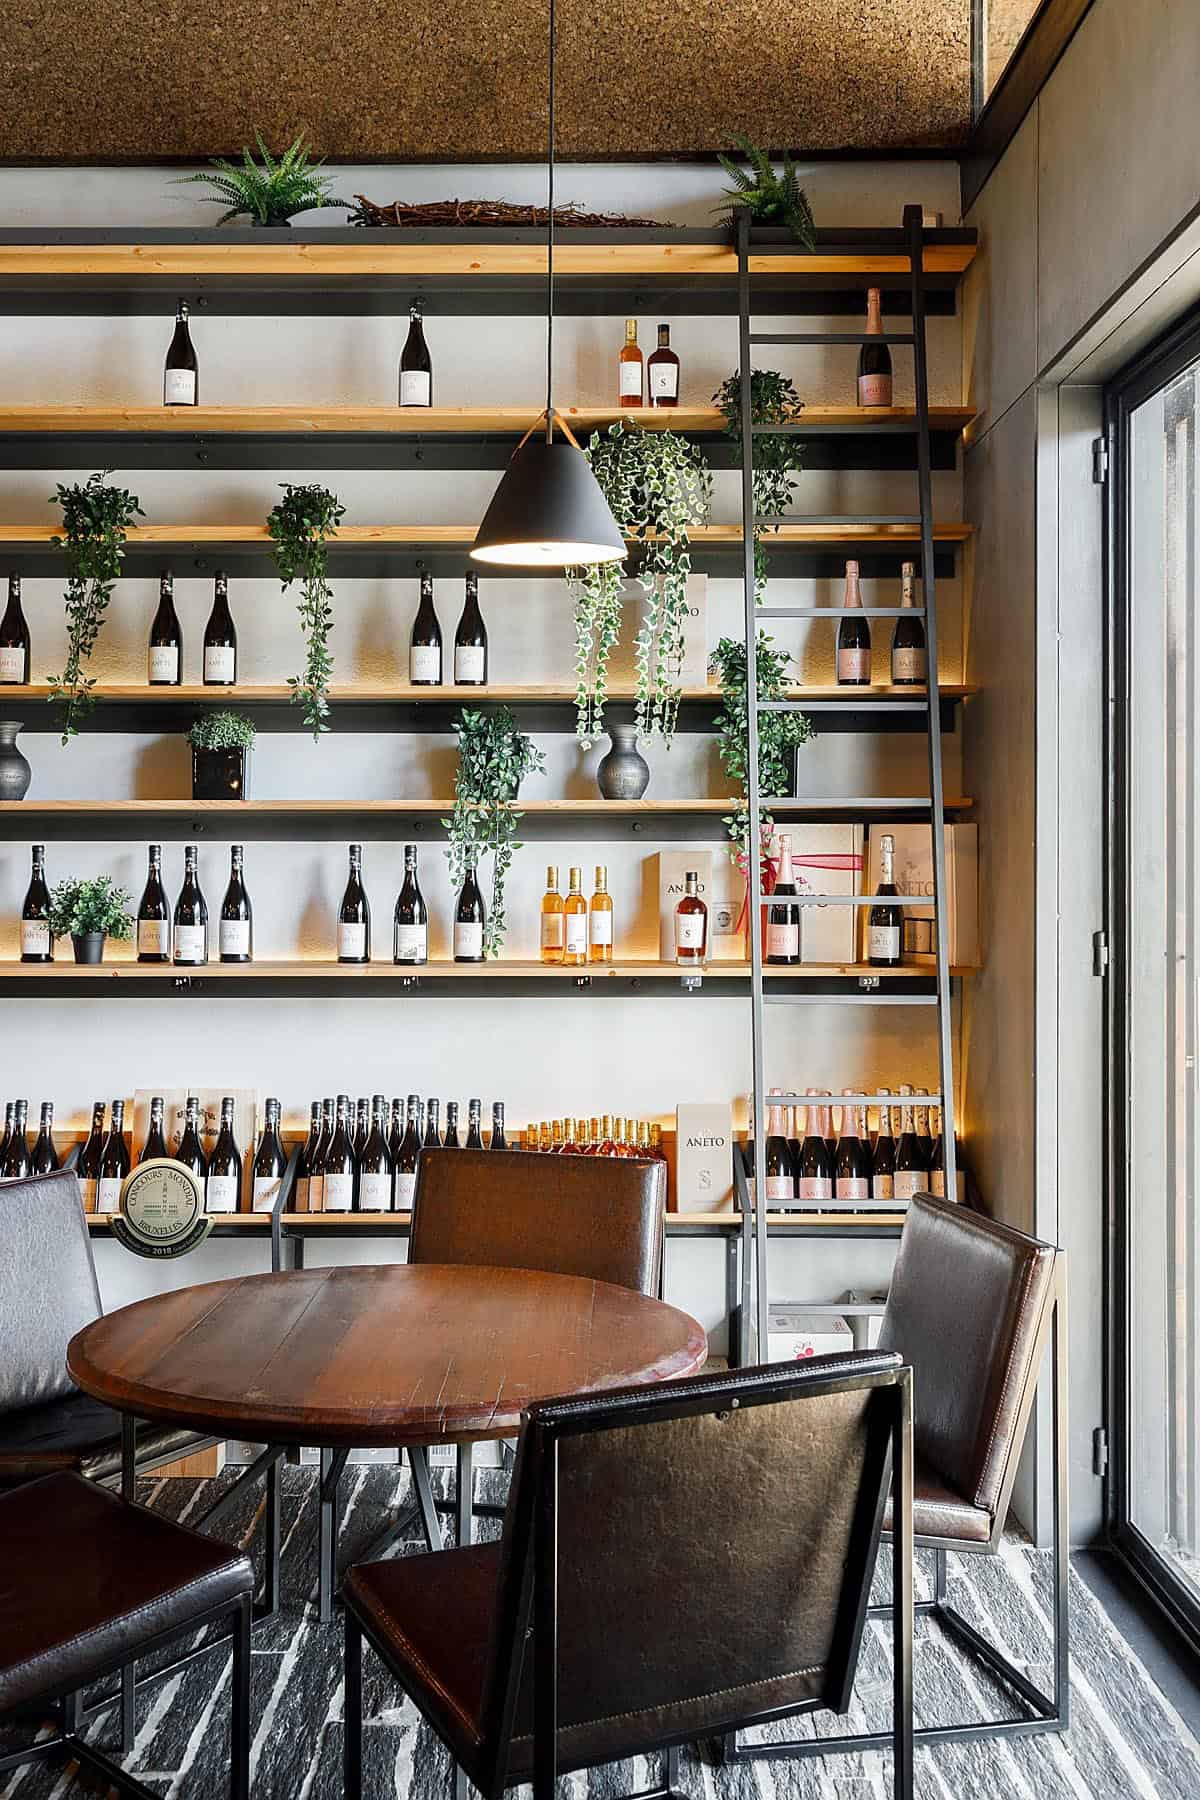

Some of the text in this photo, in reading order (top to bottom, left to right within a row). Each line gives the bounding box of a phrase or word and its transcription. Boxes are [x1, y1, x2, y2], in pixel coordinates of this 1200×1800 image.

[667, 884, 705, 894] ANO
[686, 1136, 725, 1148] ANETO
[129, 1169, 163, 1207] CONCOURS
[138, 1219, 184, 1236] BRUXELLES
[152, 1246, 172, 1255] 2018
